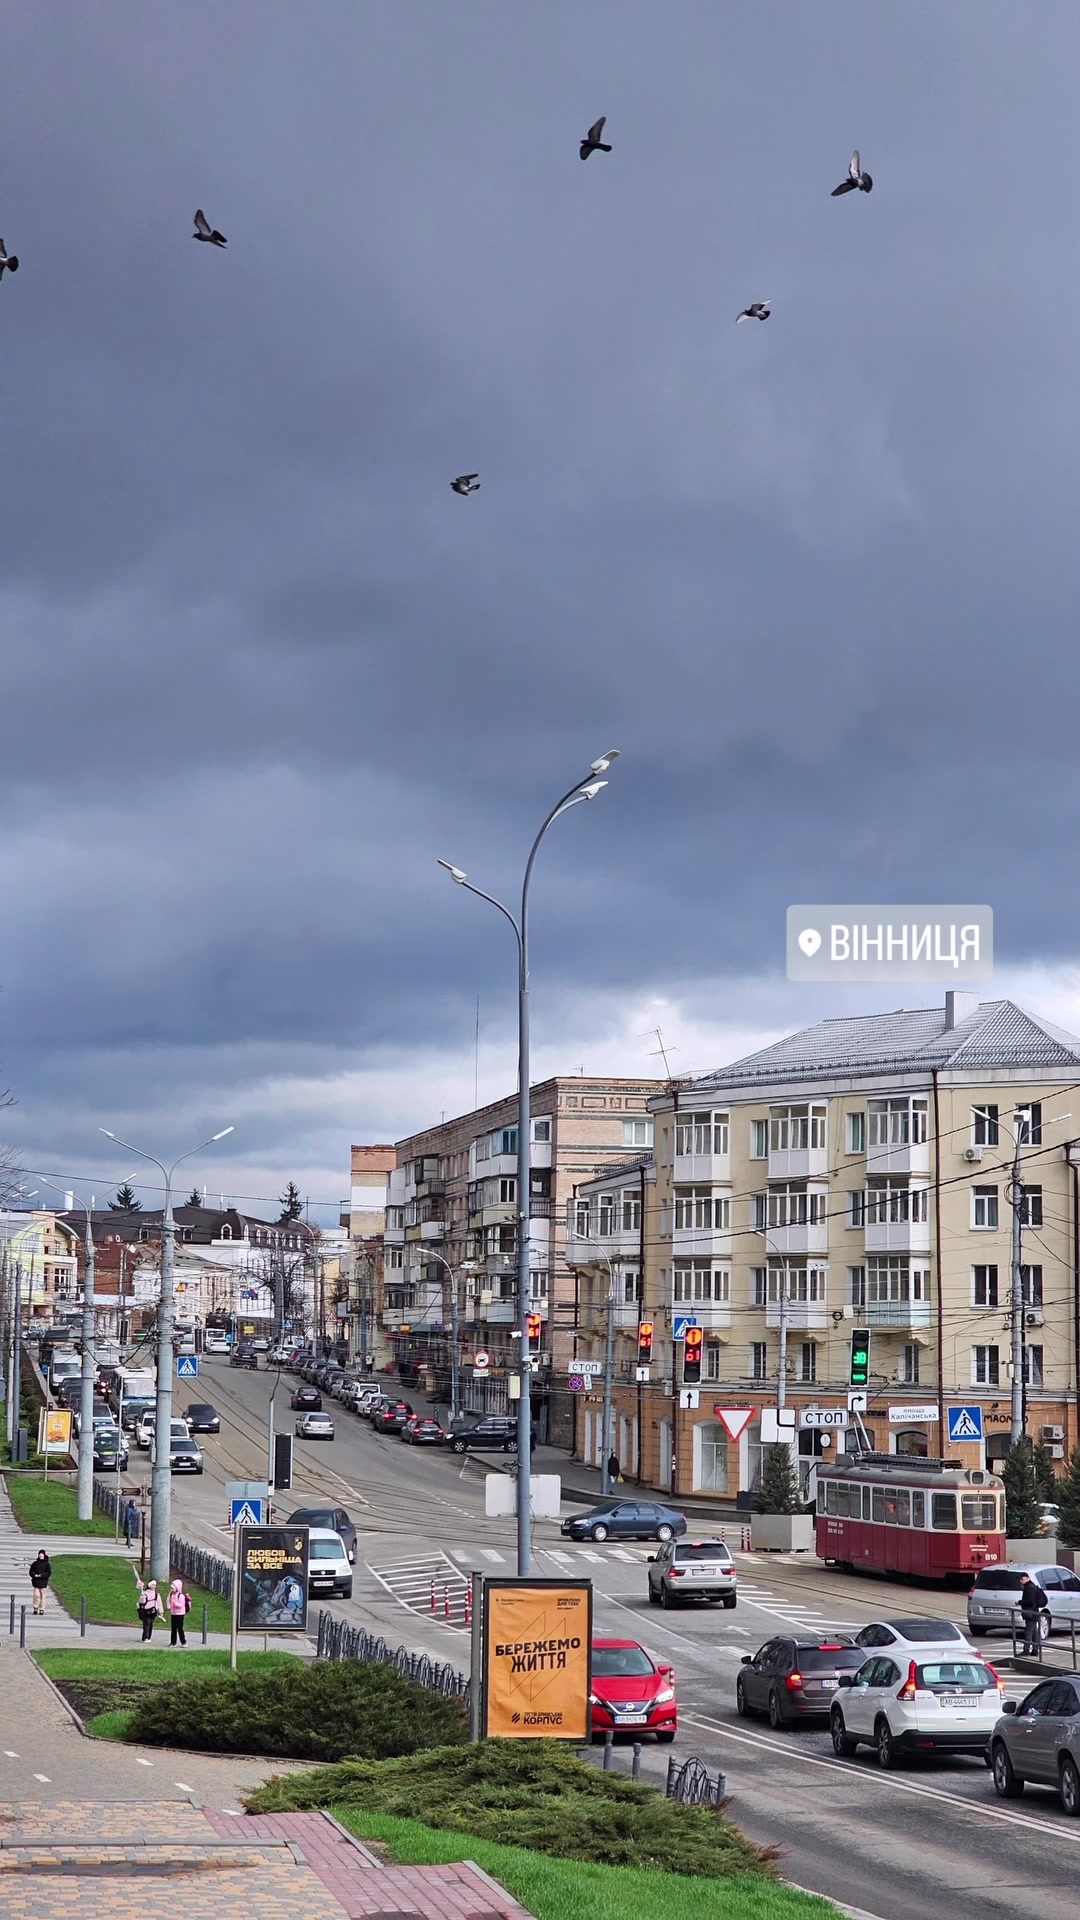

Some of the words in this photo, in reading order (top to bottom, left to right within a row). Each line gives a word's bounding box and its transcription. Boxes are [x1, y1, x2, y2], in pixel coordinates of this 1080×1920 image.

[572, 1363, 598, 1372] СТОП
[805, 1412, 843, 1424] СТОП
[495, 1637, 581, 1657] БЕРЕЖЕМО
[511, 1651, 567, 1673] ЖИТТЯ
[523, 1716, 563, 1725] КОРПУС
